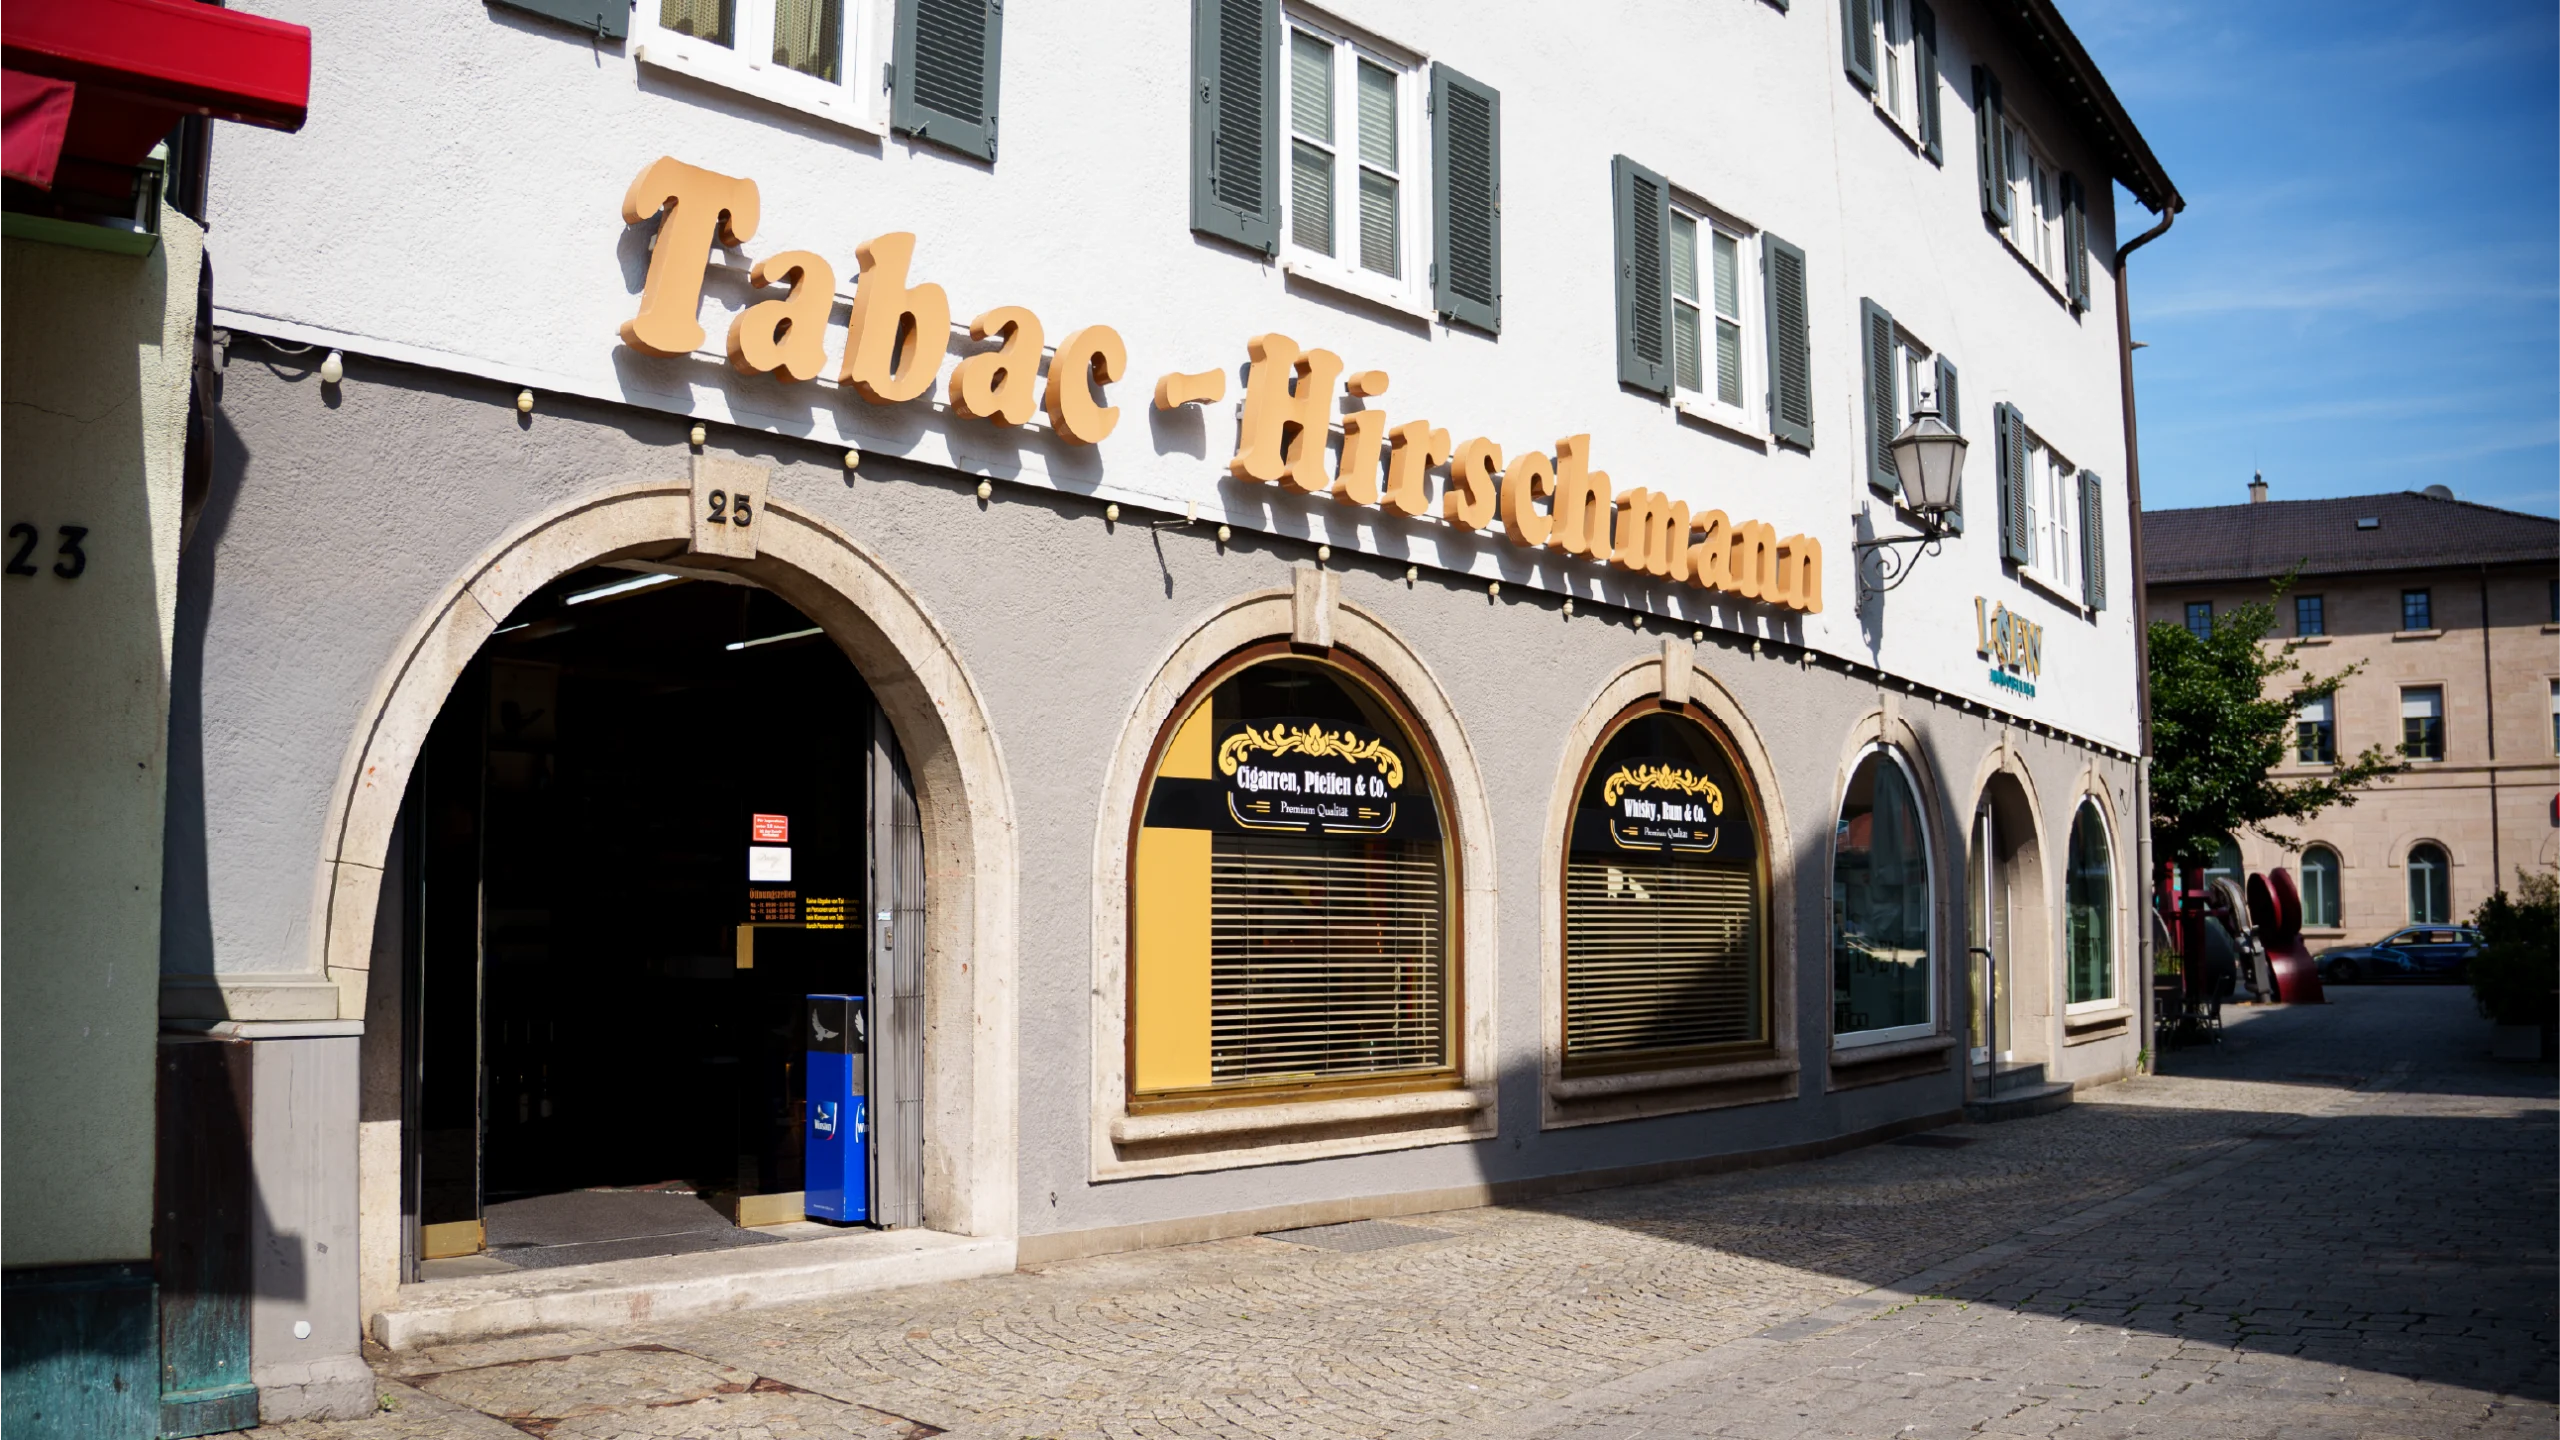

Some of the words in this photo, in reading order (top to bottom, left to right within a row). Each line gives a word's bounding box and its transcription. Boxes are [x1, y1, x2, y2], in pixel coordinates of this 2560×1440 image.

[619, 155, 1128, 446] Tabac
[1229, 331, 1823, 615] Hirschmann
[706, 489, 753, 528] 25
[5, 522, 89, 579] 23
[1236, 765, 1301, 795] Cigarren,
[1304, 770, 1352, 796] Pfeifen
[1354, 774, 1366, 797] &
[1369, 775, 1388, 799] Co.
[1280, 800, 1315, 815] Premium
[1661, 801, 1683, 821] Rum
[1684, 803, 1692, 822] &
[1693, 804, 1707, 823] Co.
